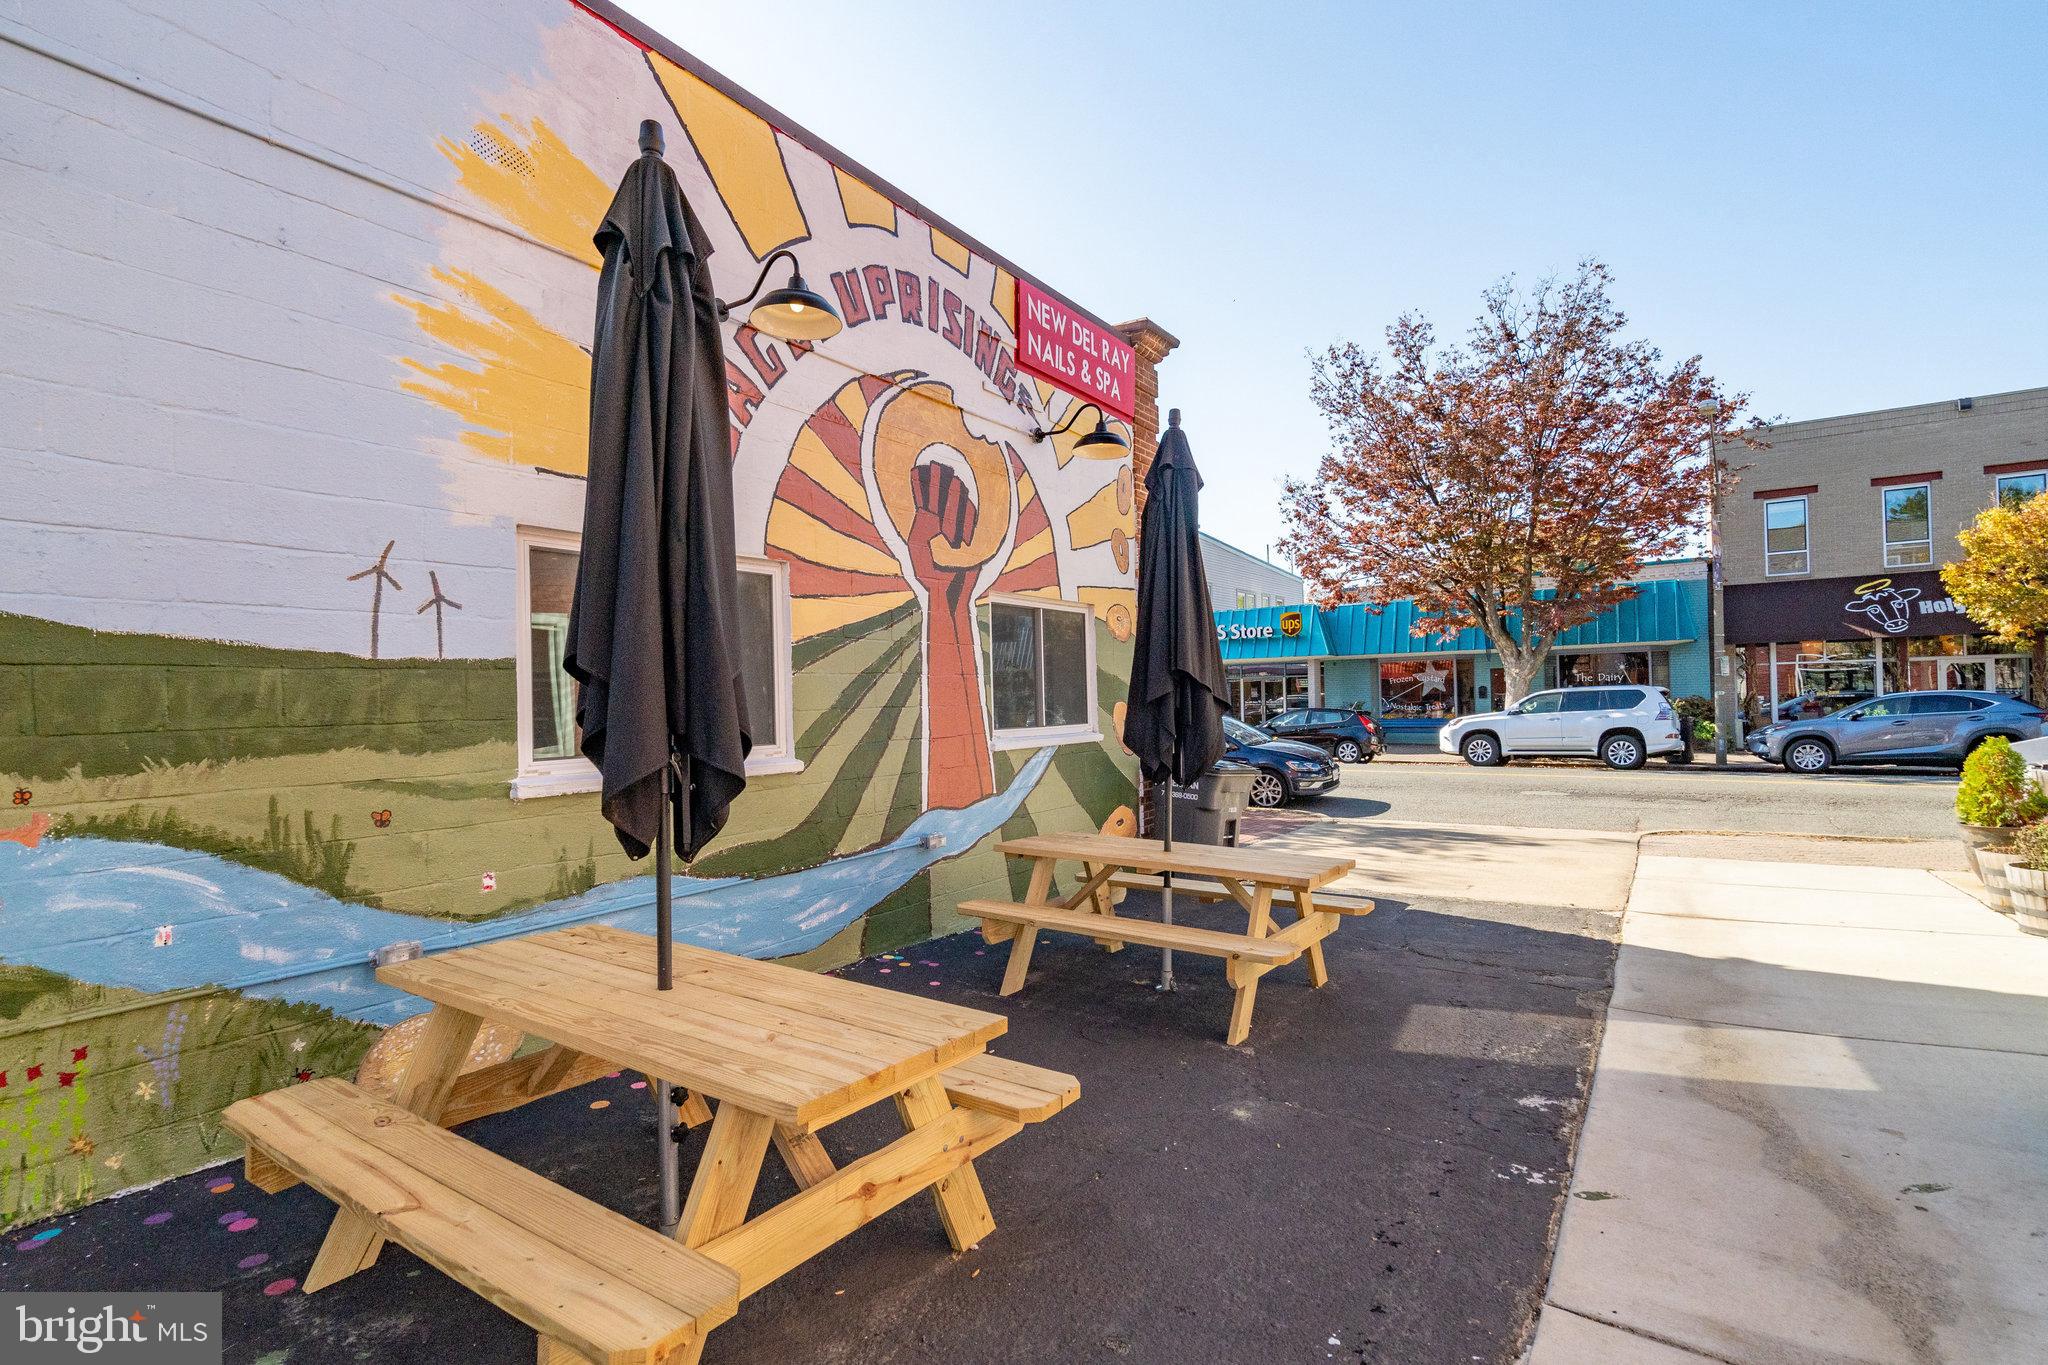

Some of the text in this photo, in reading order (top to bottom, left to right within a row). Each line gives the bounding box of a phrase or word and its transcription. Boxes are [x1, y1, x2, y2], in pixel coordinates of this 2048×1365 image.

[829, 264, 1018, 405] UPRISING
[1027, 293, 1130, 374] NEW DEL RAY
[1028, 329, 1121, 401] NAILS & SPA
[1229, 624, 1273, 640] Store
[1282, 620, 1301, 633] ups
[1389, 676, 1414, 685] Frozen
[1574, 672, 1625, 684] The Dairy
